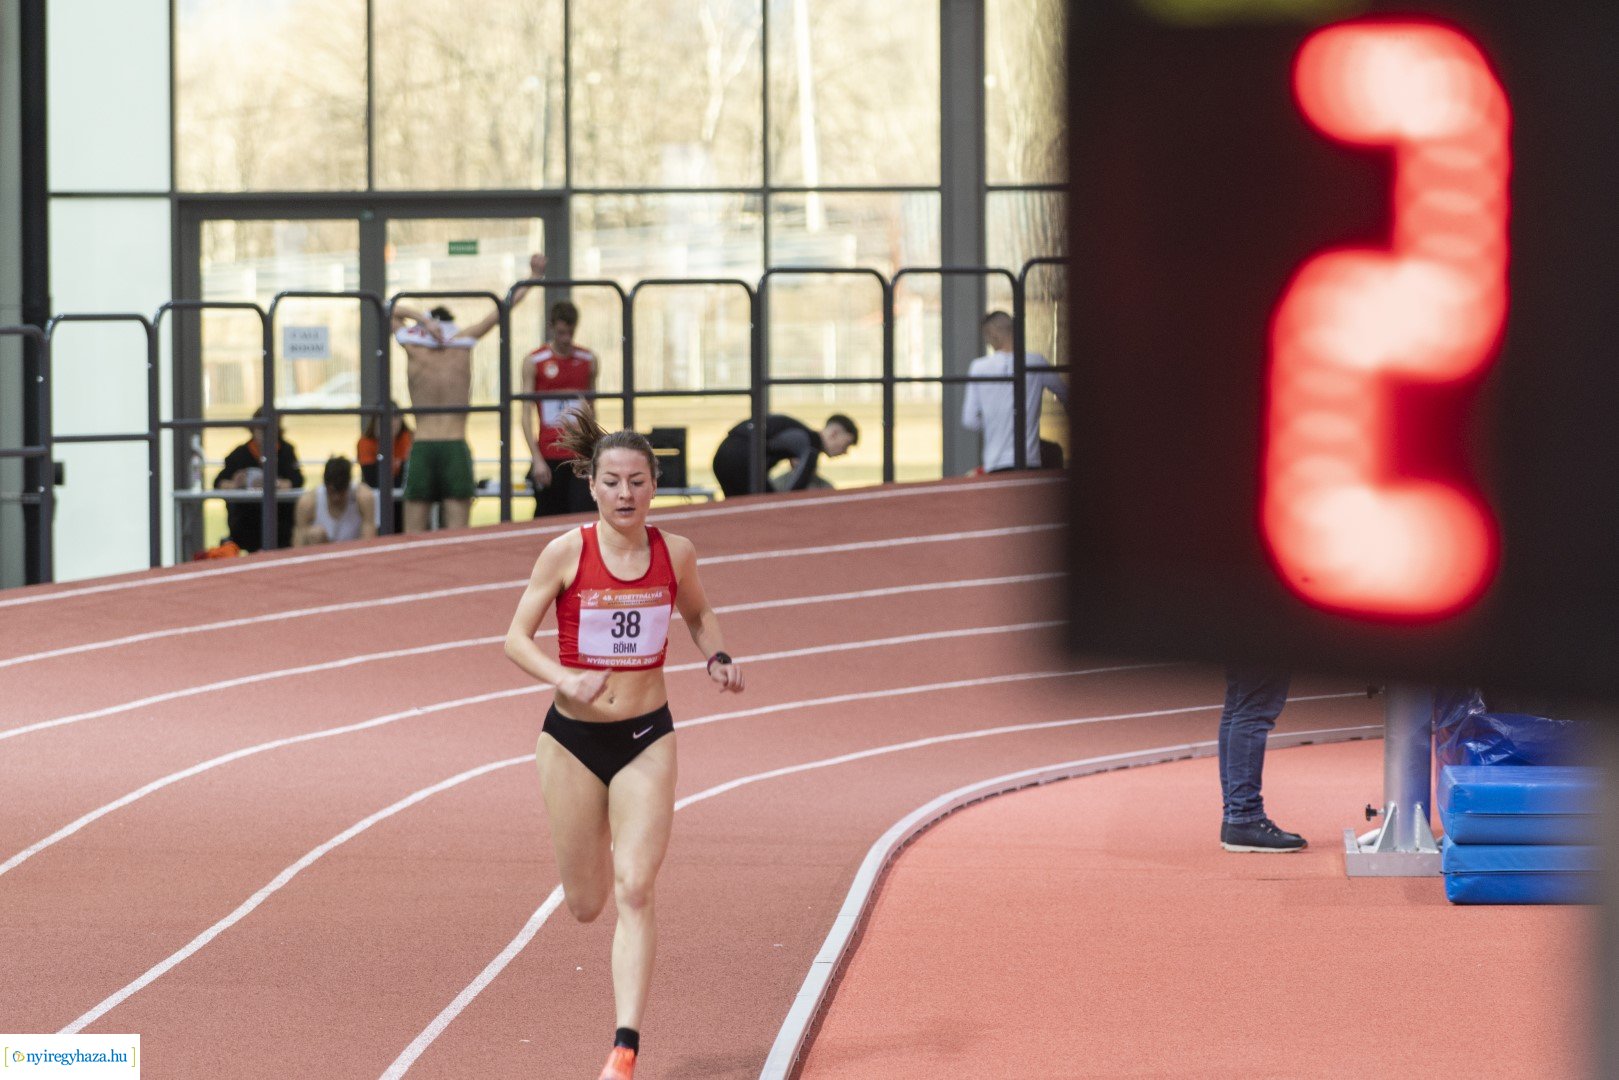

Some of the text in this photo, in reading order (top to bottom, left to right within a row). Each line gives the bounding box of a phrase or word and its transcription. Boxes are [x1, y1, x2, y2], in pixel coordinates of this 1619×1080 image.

[1263, 17, 1511, 624] 2
[611, 610, 641, 638] 38
[613, 641, 637, 653] BÖHM
[587, 656, 642, 665] NYÍREGYHÁZA
